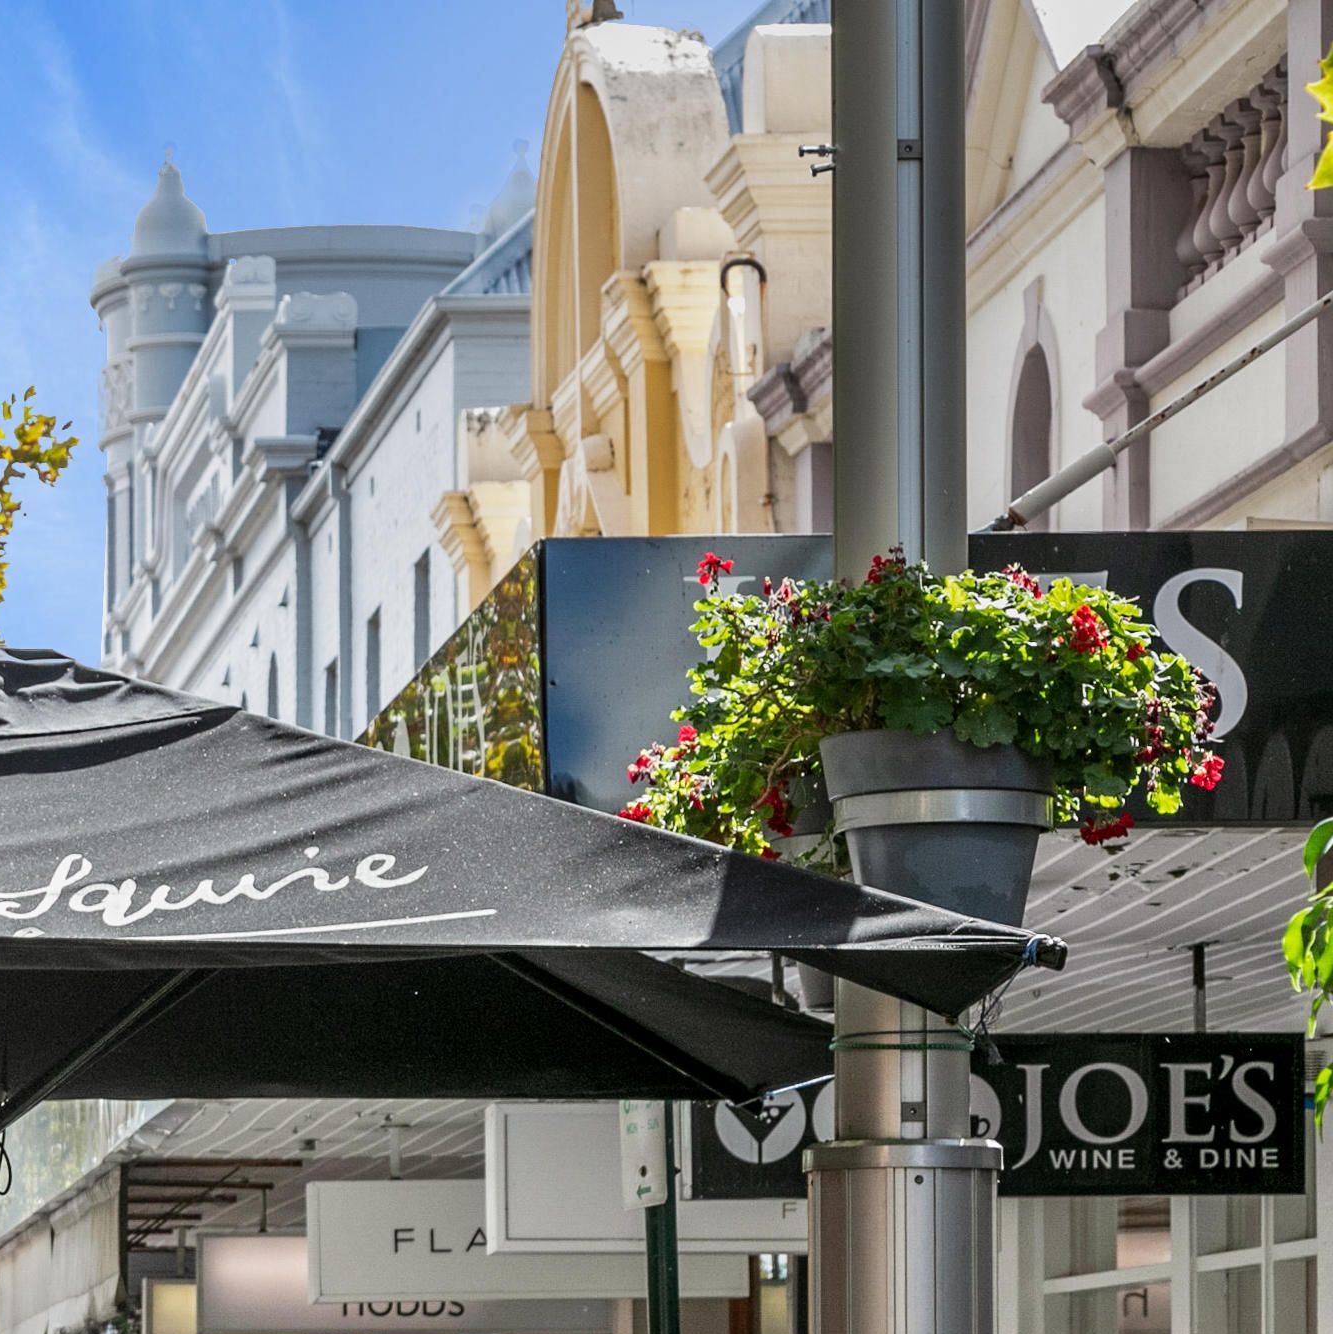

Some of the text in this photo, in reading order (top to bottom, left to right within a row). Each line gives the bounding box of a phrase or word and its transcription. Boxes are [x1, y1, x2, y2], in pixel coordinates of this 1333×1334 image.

[1012, 1054, 1278, 1170] JOE'S
[1049, 1148, 1280, 1170] WINE & DINE
